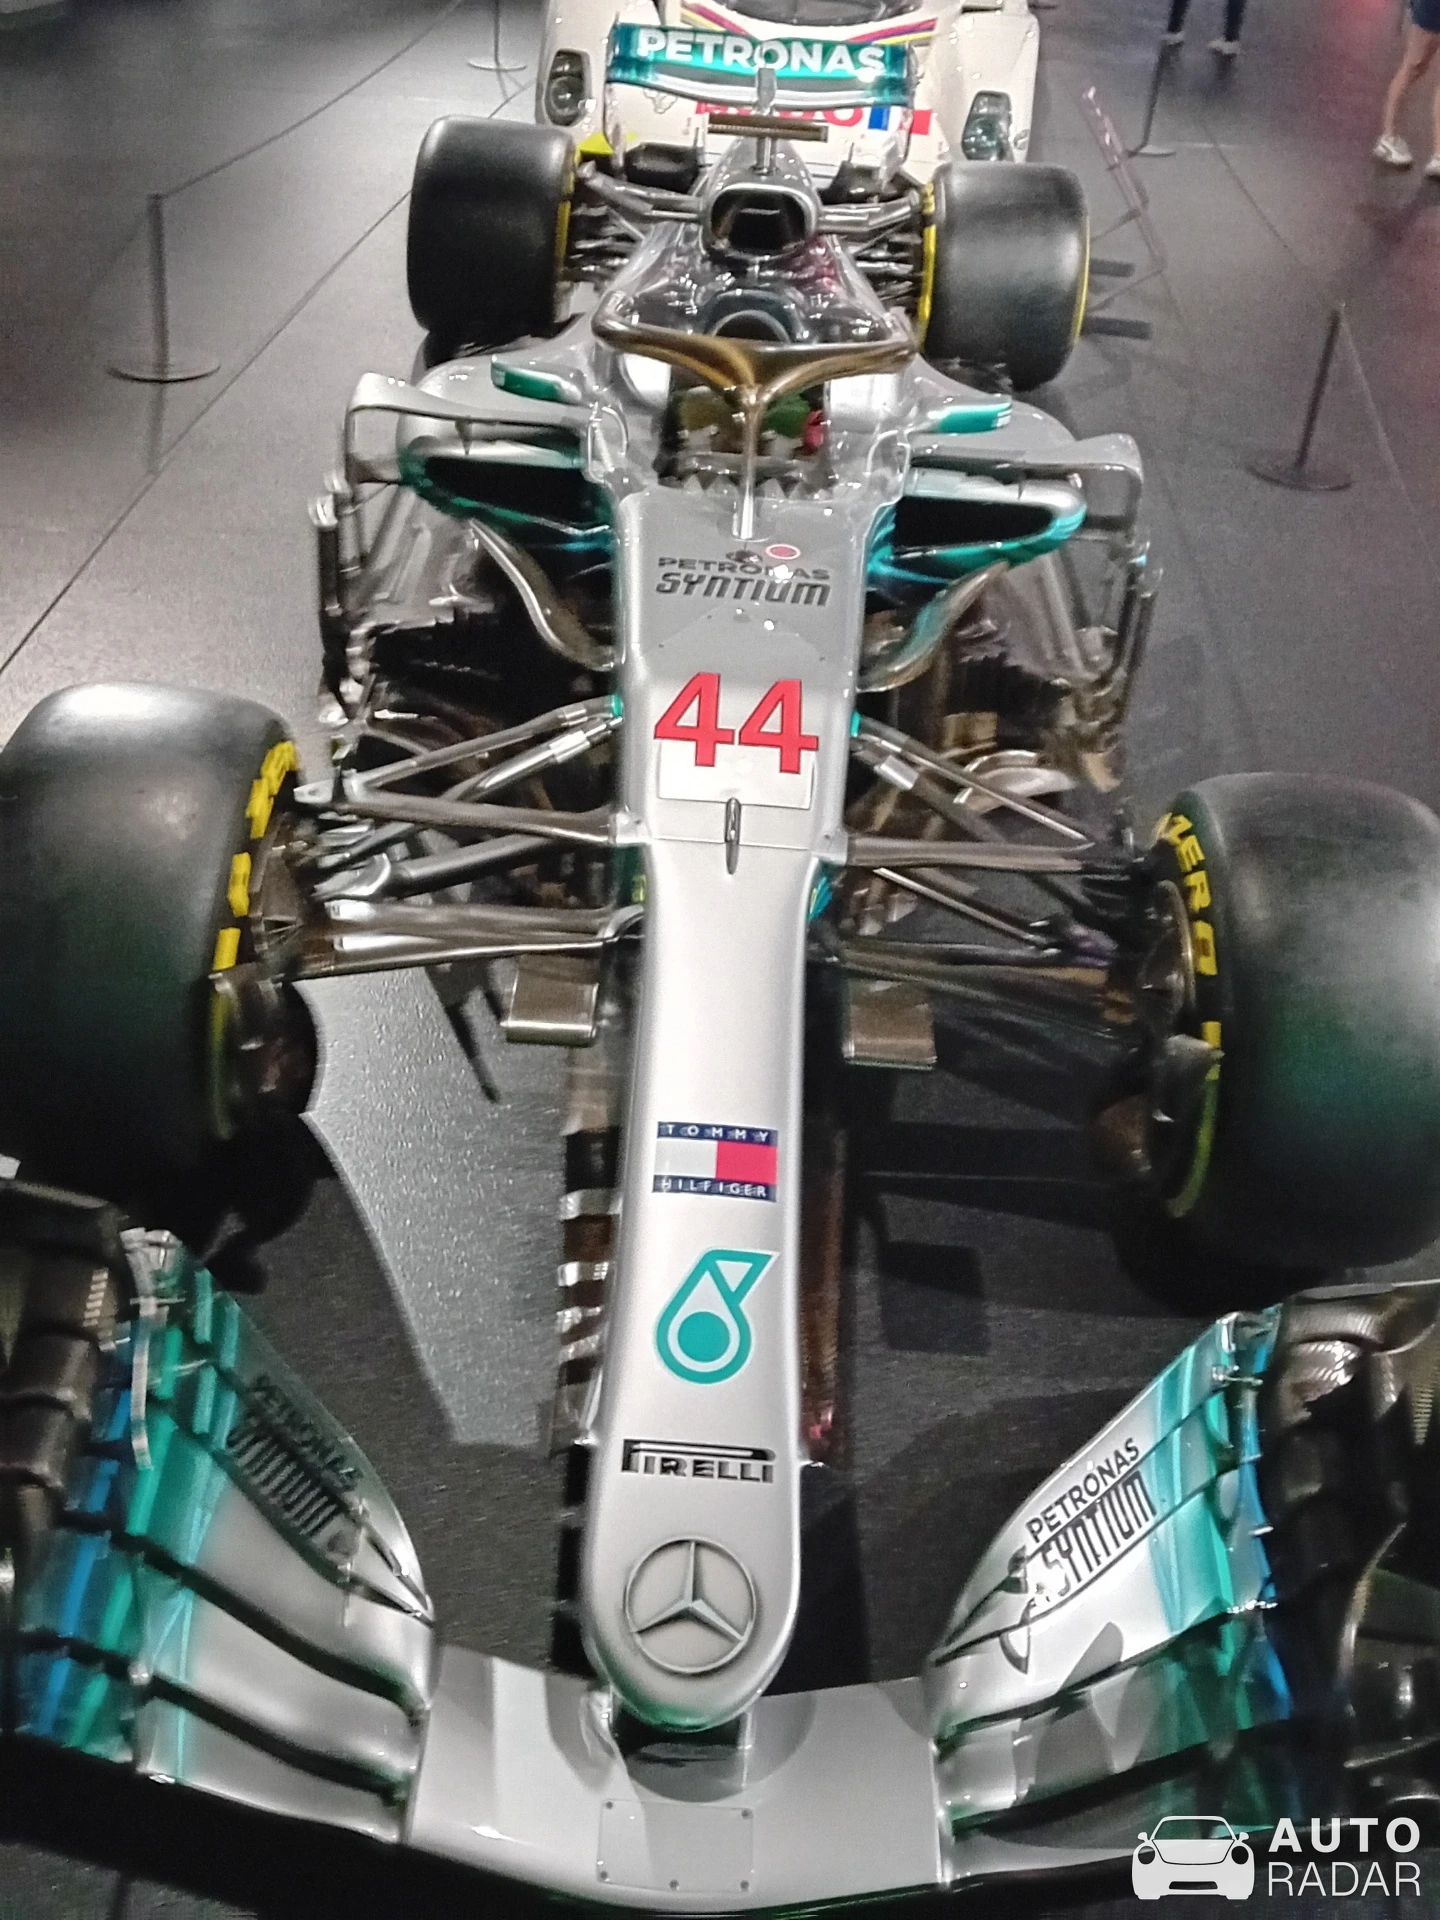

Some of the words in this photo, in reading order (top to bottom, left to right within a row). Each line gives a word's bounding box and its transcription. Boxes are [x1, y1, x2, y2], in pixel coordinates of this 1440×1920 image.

[636, 28, 888, 77] PETRONAS
[656, 572, 831, 607] SYNTIUM
[653, 671, 820, 775] 44
[666, 1124, 769, 1142] TOMMY
[660, 1177, 767, 1198] HILFIGER
[621, 1438, 777, 1484] PIRELLI
[1025, 1437, 1140, 1544] PETRONAS
